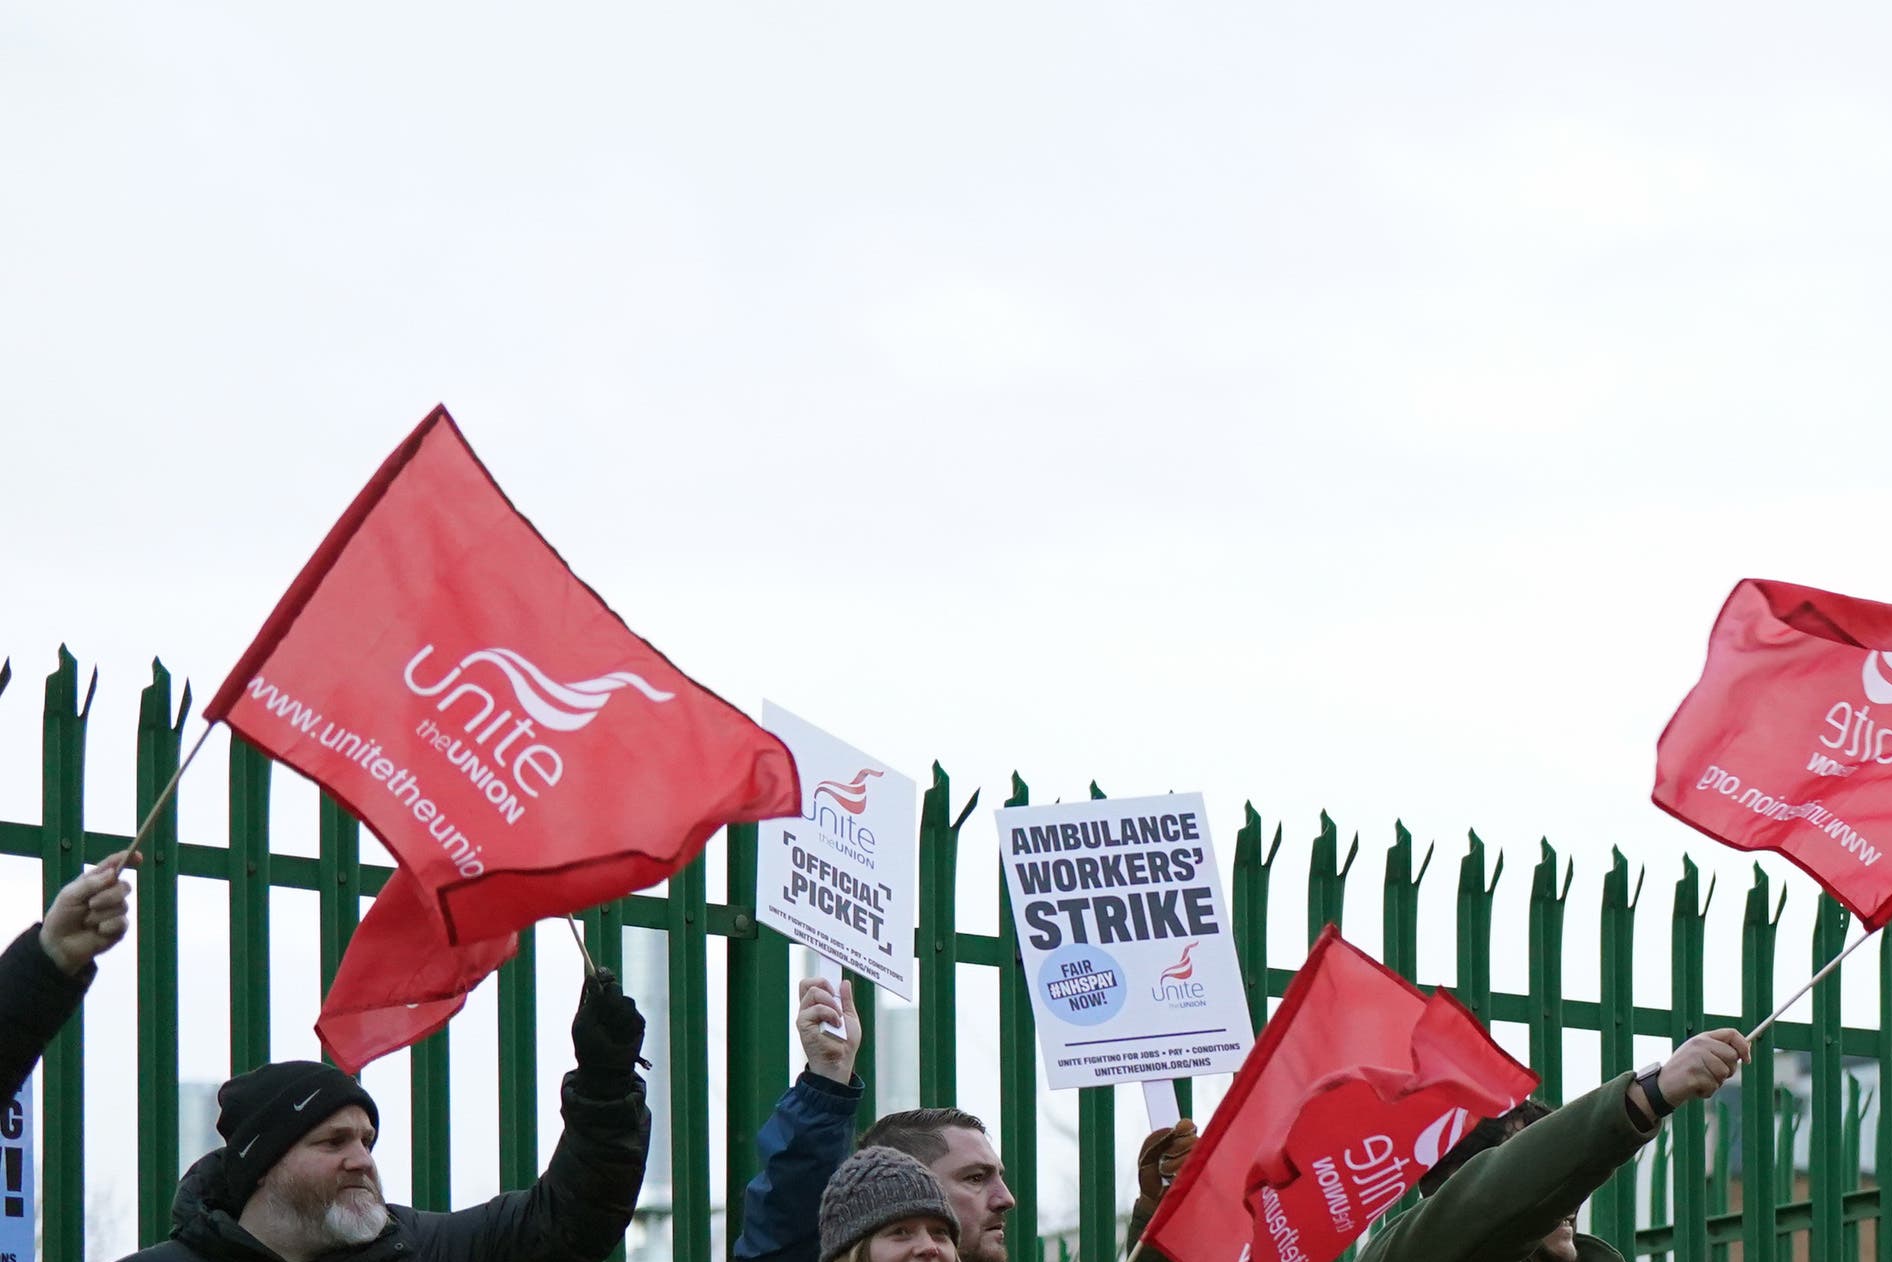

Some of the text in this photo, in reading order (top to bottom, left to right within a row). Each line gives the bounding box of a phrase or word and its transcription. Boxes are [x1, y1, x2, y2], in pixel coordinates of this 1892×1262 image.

[404, 644, 563, 798] unite
[1011, 812, 1200, 856] AMBULANCE
[792, 846, 885, 914] OFFICIAL
[791, 870, 885, 942] PICKET
[1024, 887, 1220, 951] STRIKE
[768, 904, 788, 920] UNITE
[787, 914, 817, 935] FIGHTING
[816, 930, 830, 941] FOR
[830, 937, 845, 951] JOBS
[868, 958, 904, 982] CONDITIONS
[793, 928, 881, 981] UNITETHEUNION.ORG/NHS
[1050, 972, 1116, 999] #NHSPAY
[1060, 959, 1093, 978] FAIR
[1068, 992, 1108, 1012] NOW!
[1152, 981, 1205, 1002] unite
[1058, 1043, 1241, 1067] UNITE FIGHTING FOR JOBS PAY CONDITIONS
[1094, 1057, 1211, 1077] UNITETHEUNION.ORG/NHS
